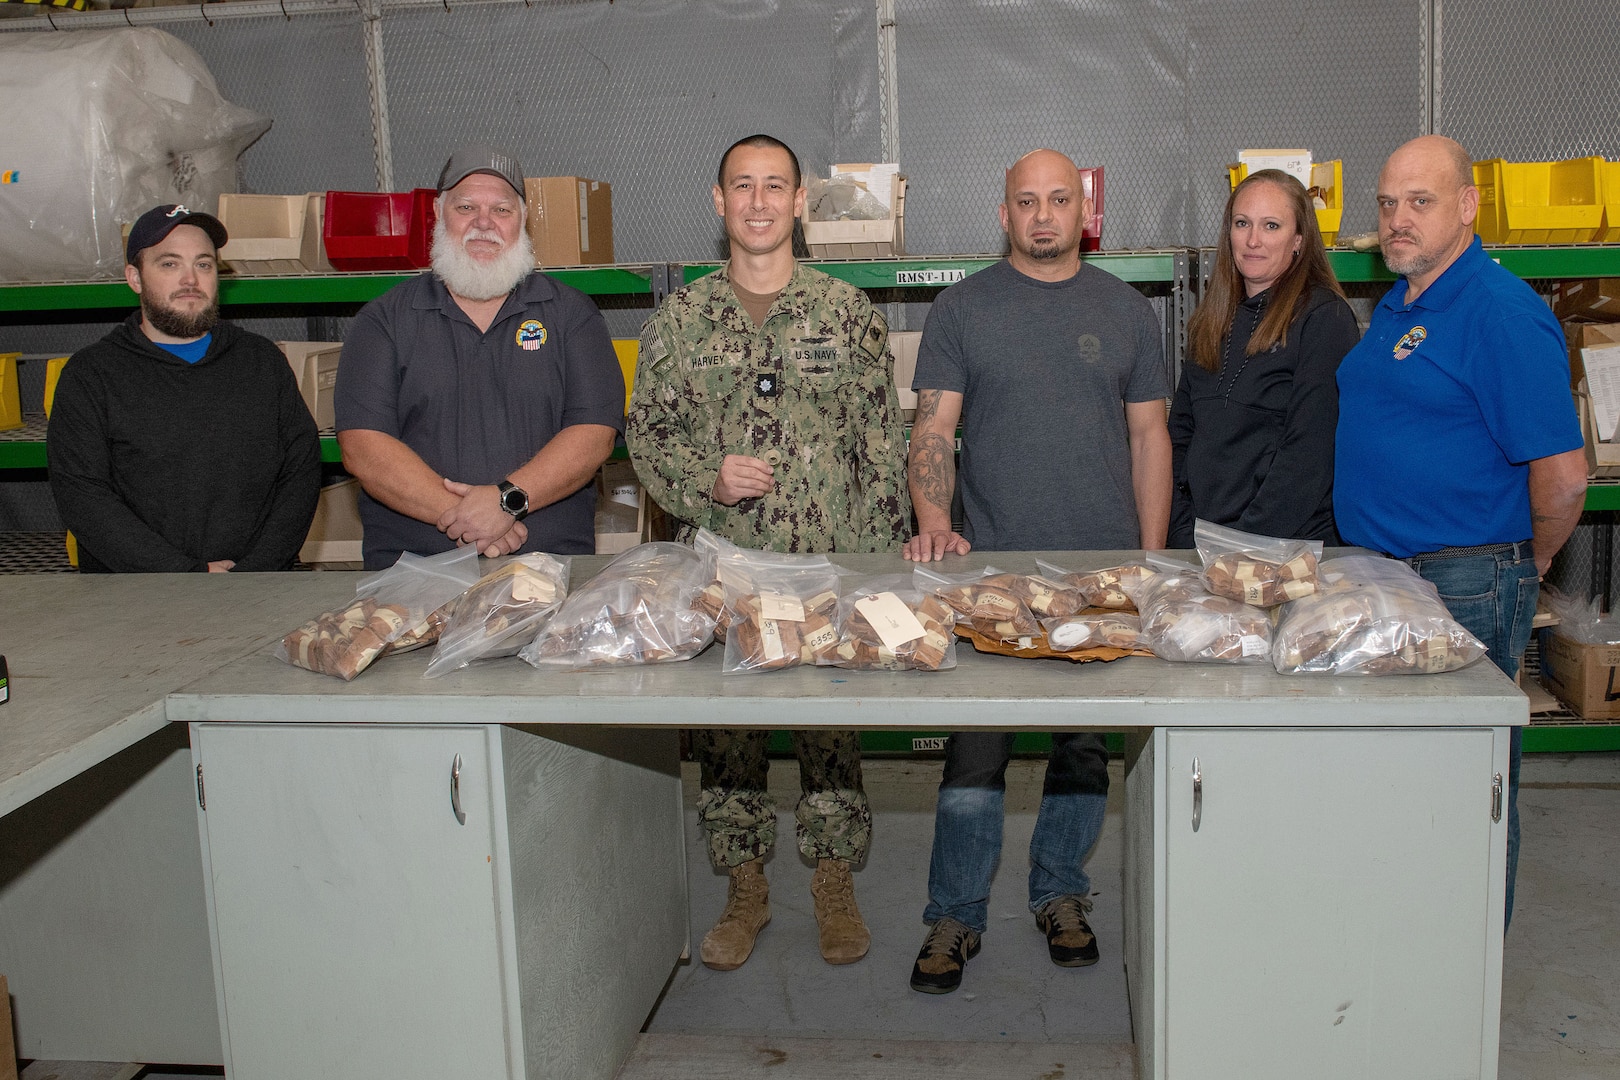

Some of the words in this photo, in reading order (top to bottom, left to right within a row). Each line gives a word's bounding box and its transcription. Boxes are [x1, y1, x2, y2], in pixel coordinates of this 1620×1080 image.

[898, 271, 964, 283] RMST-11A
[795, 350, 813, 360] U.S.
[814, 350, 838, 360] NAVY
[691, 354, 725, 369] HARVEY
